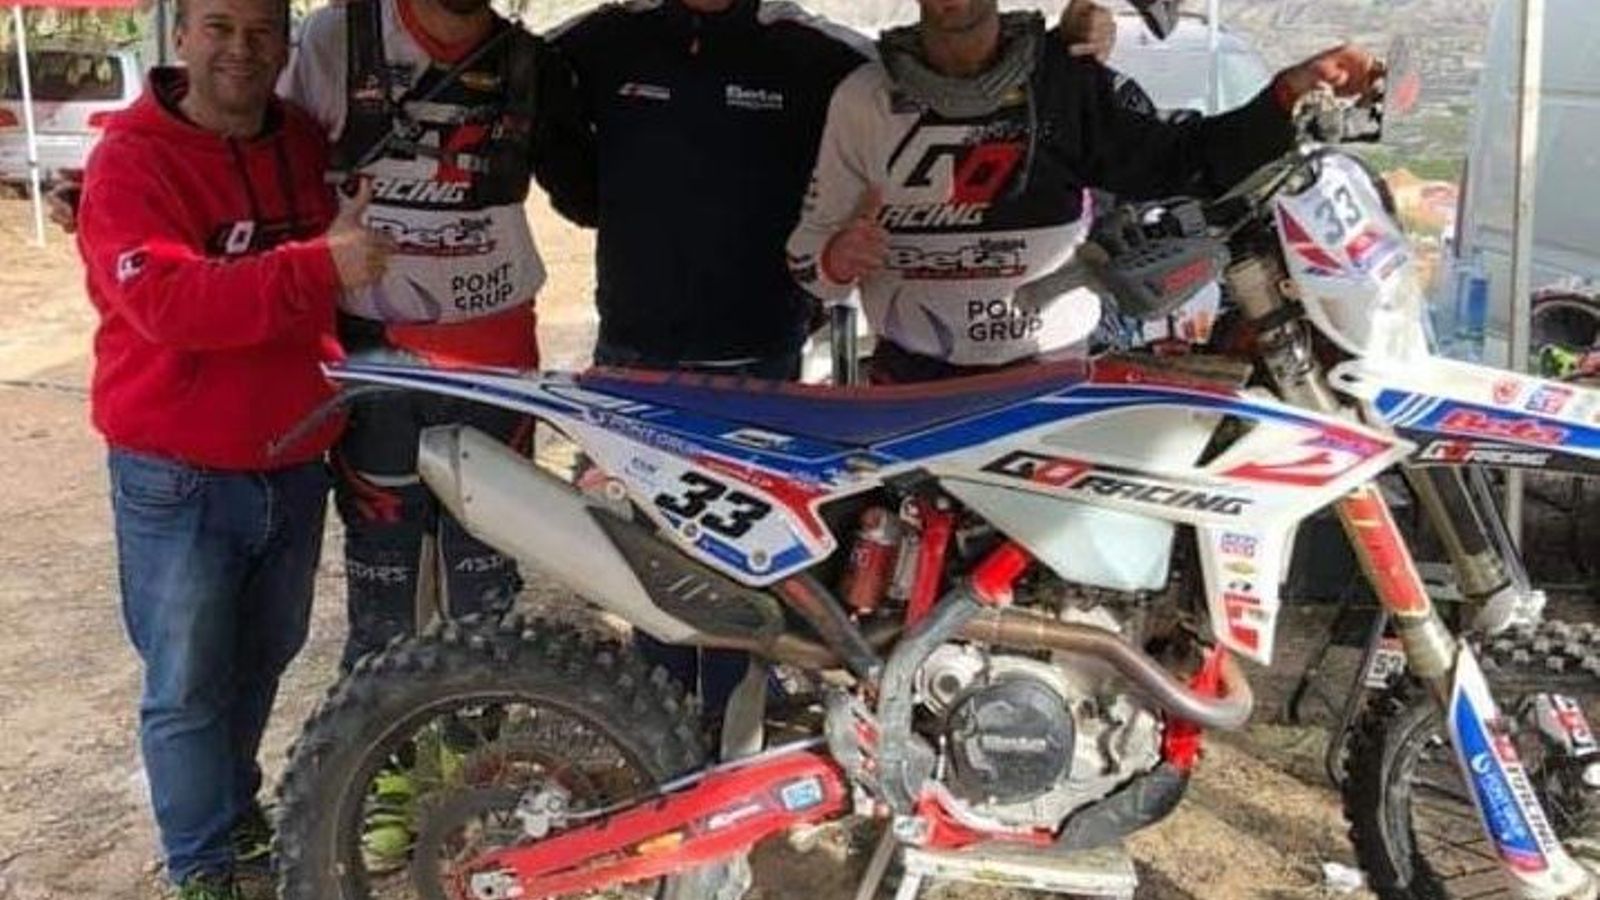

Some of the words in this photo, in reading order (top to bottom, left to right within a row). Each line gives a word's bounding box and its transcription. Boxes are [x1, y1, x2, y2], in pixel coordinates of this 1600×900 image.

[371, 178, 472, 203] ACING
[878, 203, 990, 229] ACING
[1315, 186, 1360, 244] 33
[452, 263, 512, 291] PONT
[968, 318, 1043, 342] GRUP
[655, 471, 772, 538] 33
[1070, 475, 1253, 515] RACING
